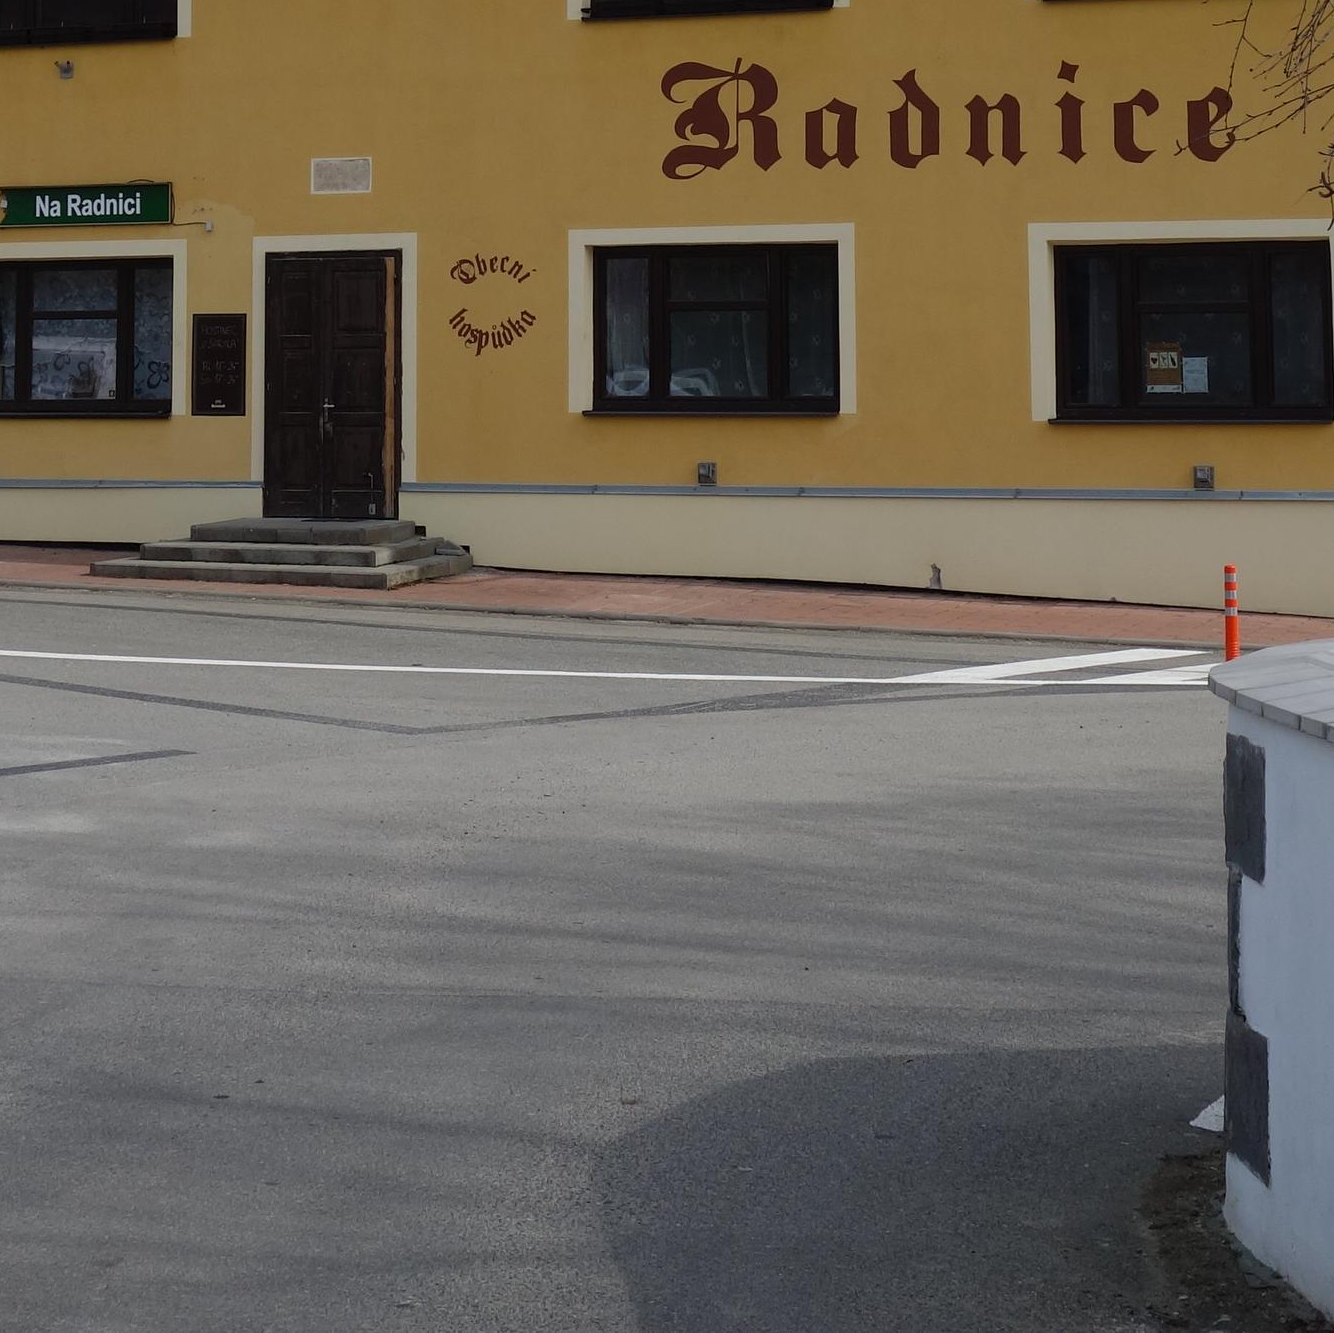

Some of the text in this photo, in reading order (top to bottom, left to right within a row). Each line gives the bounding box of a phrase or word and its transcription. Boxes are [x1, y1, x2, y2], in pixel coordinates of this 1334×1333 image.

[660, 57, 1238, 180] Radnice
[35, 192, 142, 217] Na Radnici
[449, 308, 536, 357] hospůdka
